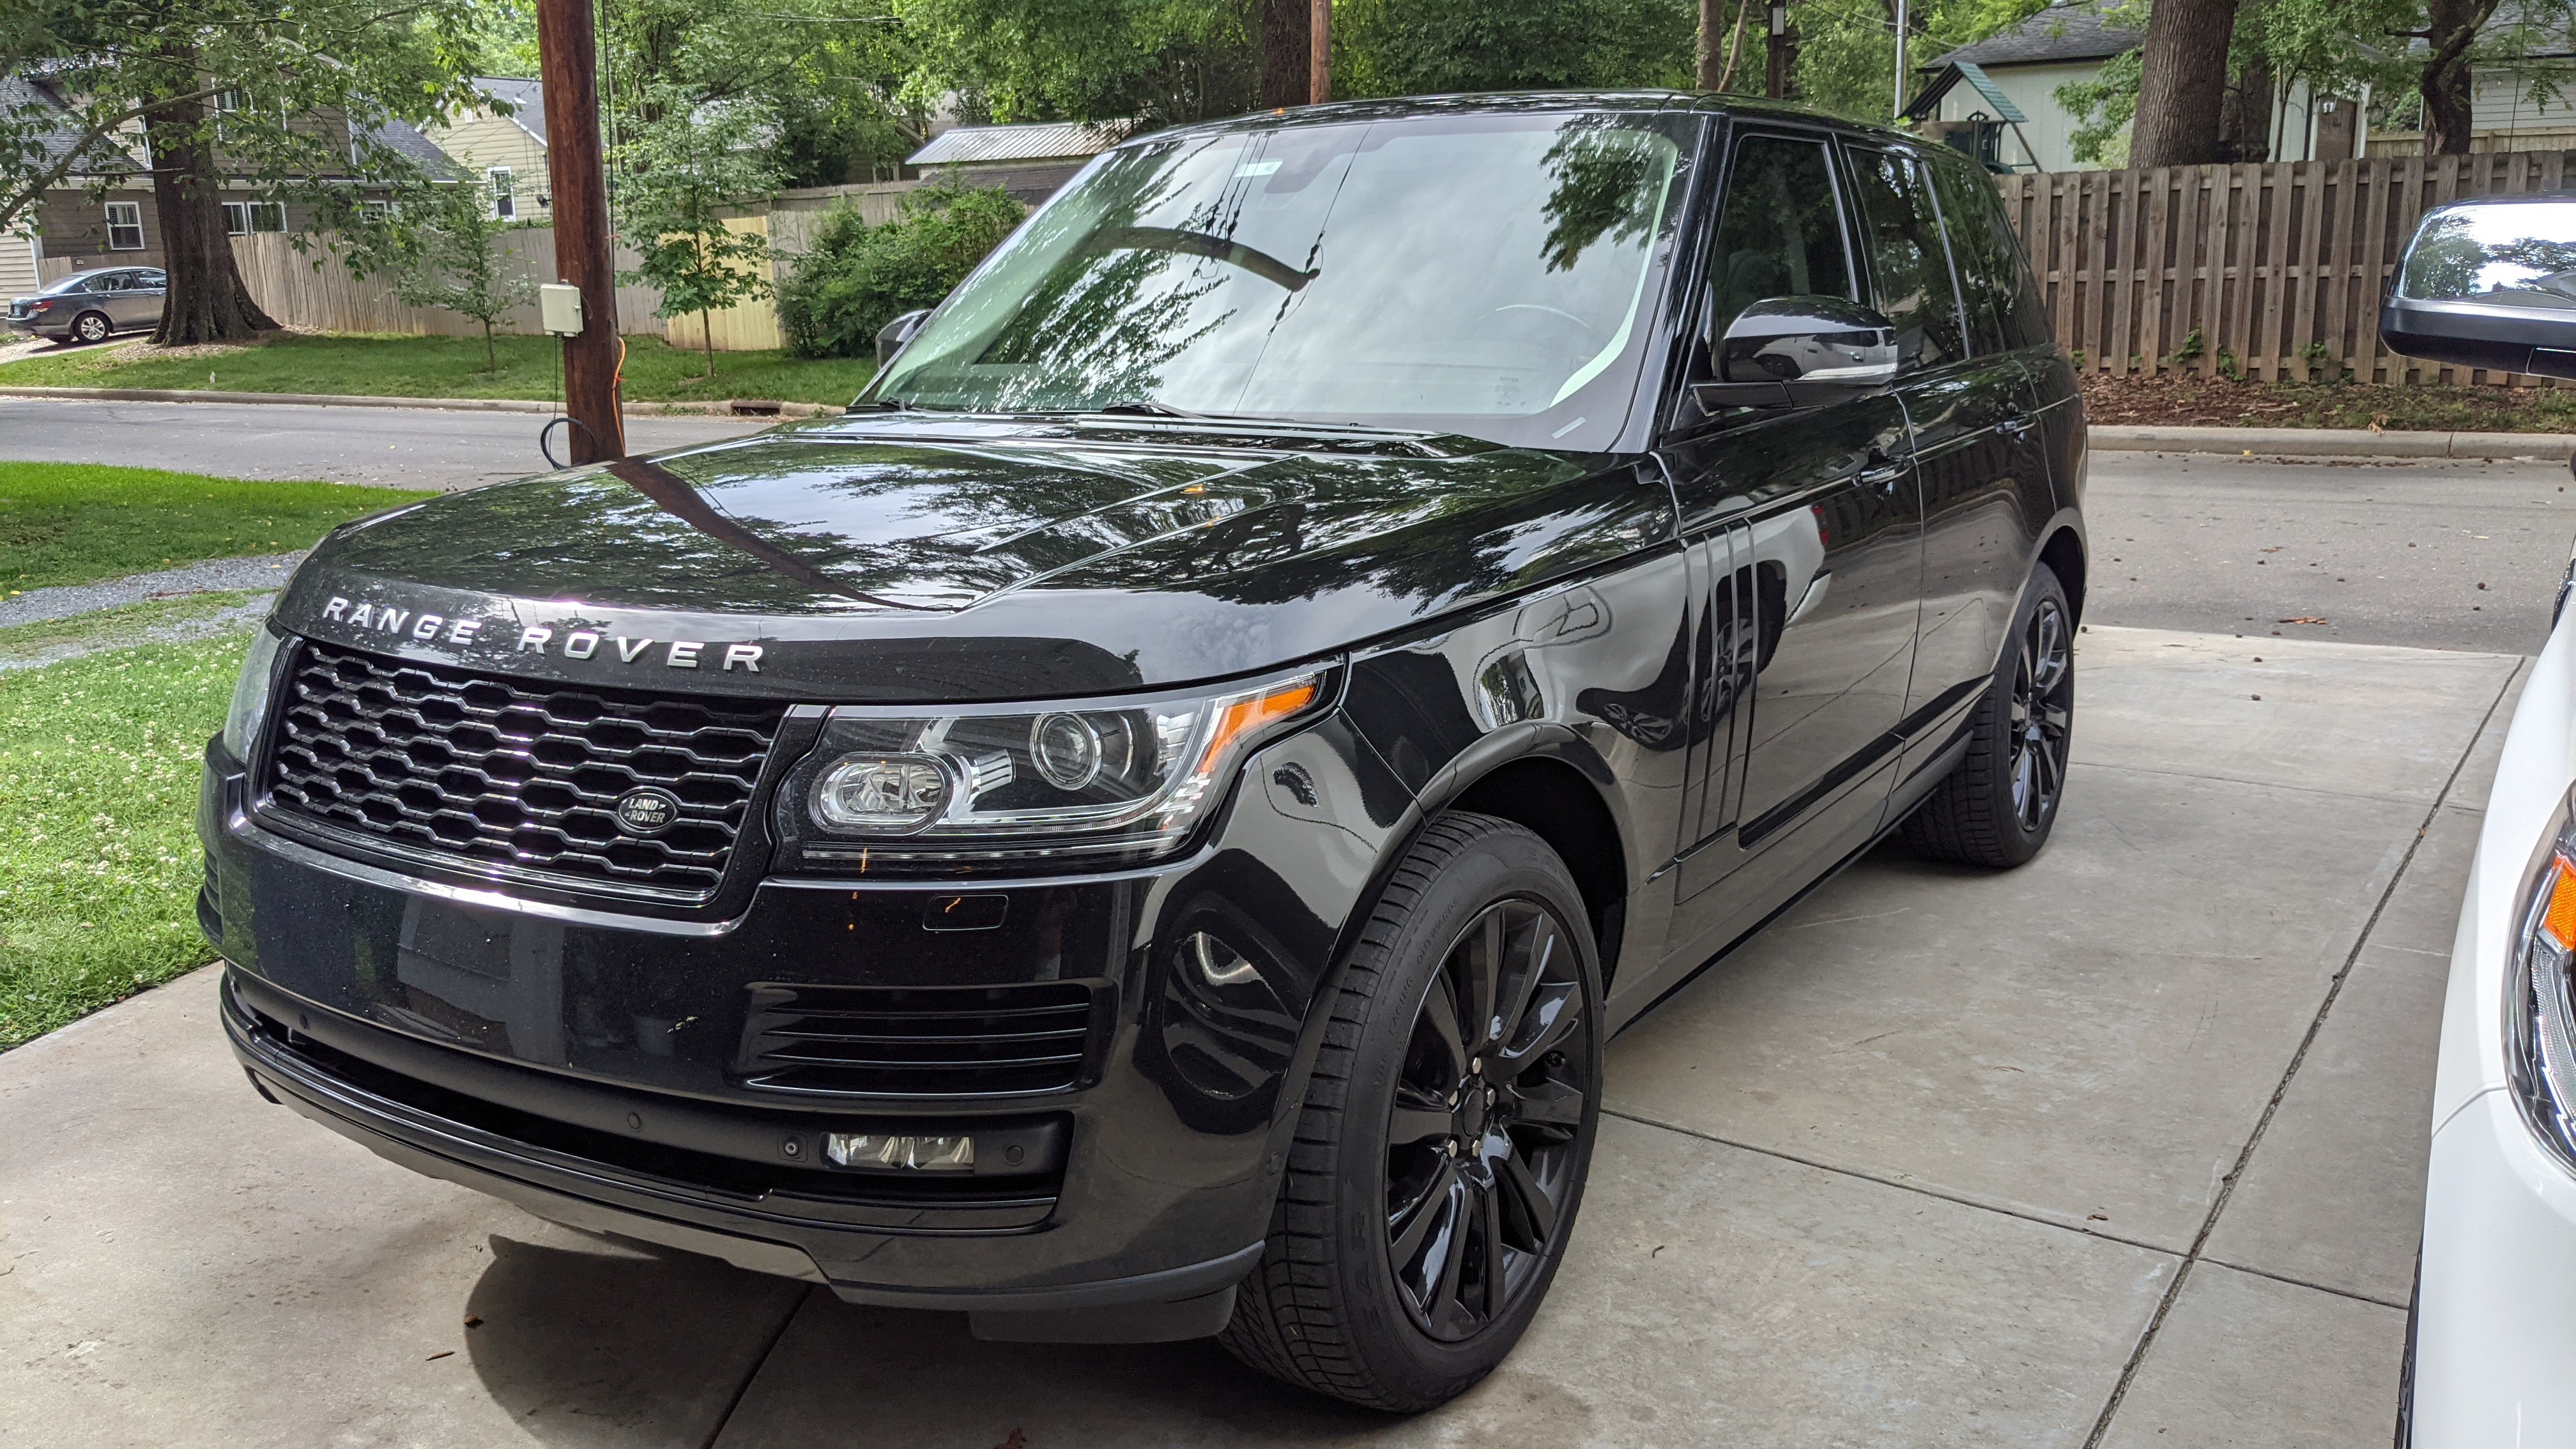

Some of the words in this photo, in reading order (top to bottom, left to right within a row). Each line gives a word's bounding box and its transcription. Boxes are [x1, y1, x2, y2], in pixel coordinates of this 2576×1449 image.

[323, 597, 482, 645] RANGE
[518, 627, 763, 672] ROVER
[628, 799, 659, 810] LAND
[629, 809, 666, 823] ROVER
